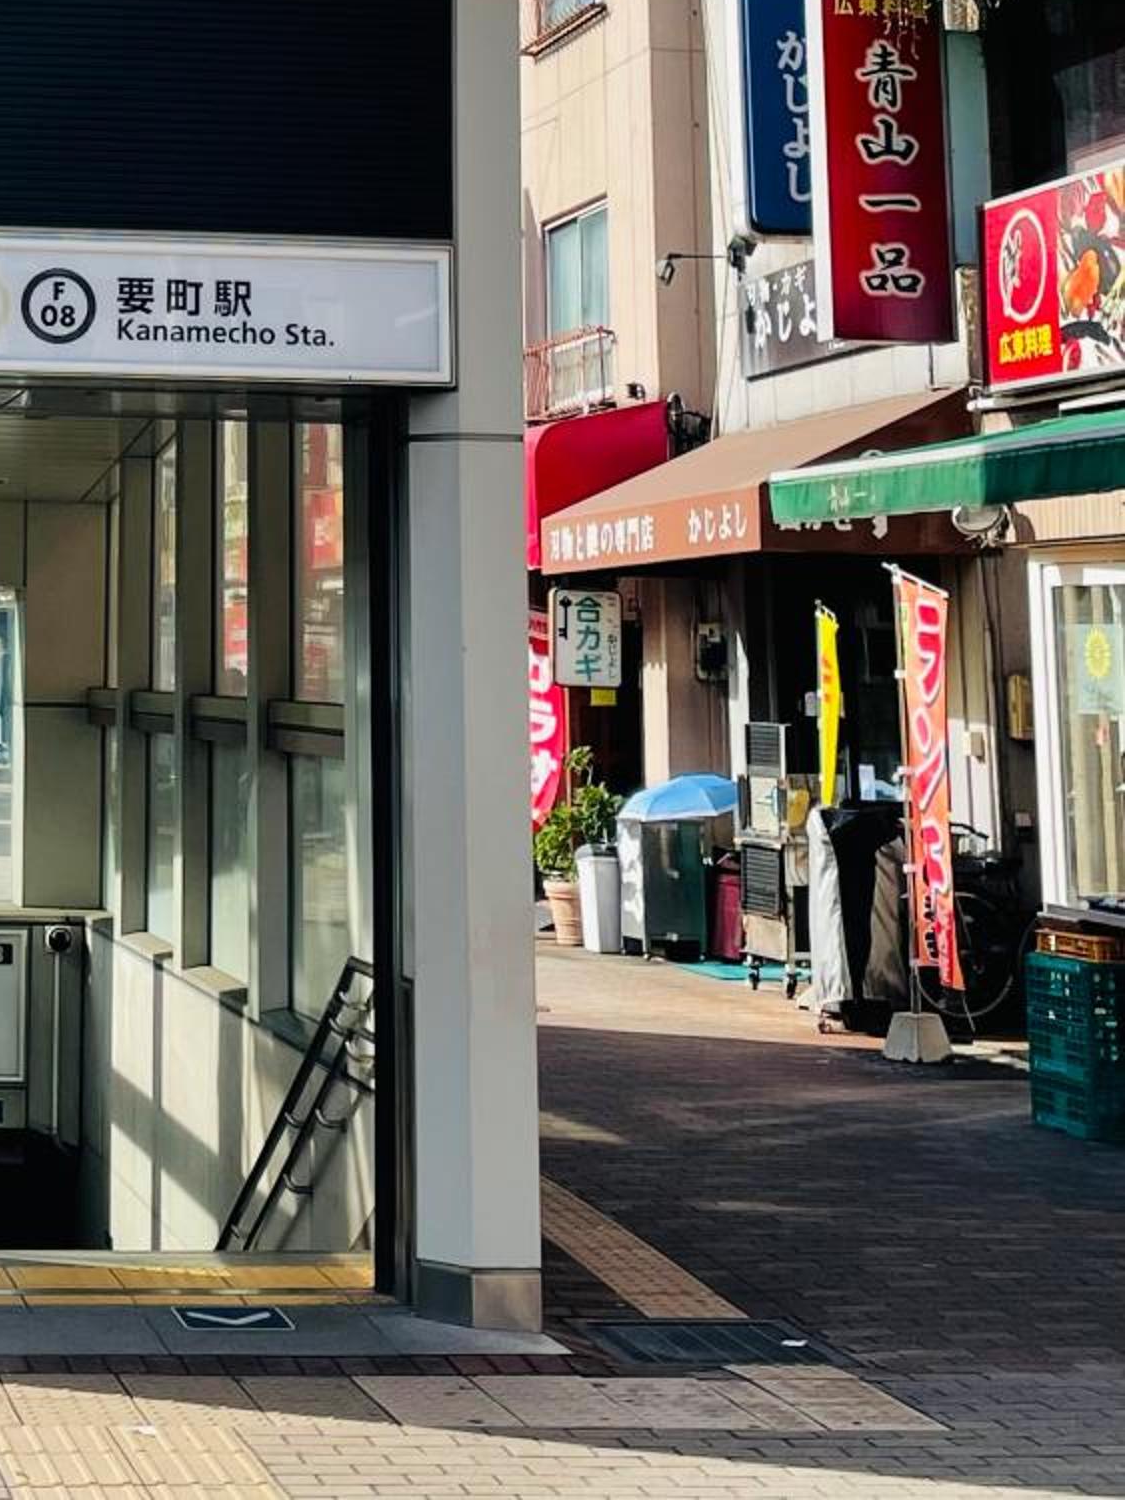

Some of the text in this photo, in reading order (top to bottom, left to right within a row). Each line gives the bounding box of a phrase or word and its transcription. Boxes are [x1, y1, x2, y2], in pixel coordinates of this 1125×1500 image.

[775, 30, 812, 202] かじよし
[856, 38, 925, 298] 青山一品
[53, 281, 66, 300] F
[116, 277, 252, 317] 要町駅
[40, 305, 75, 327] 08
[116, 319, 335, 347] Kanamecho Sta.
[998, 324, 1054, 364] 広東料理
[687, 503, 748, 545] かじよし
[574, 595, 603, 683] 合カギ
